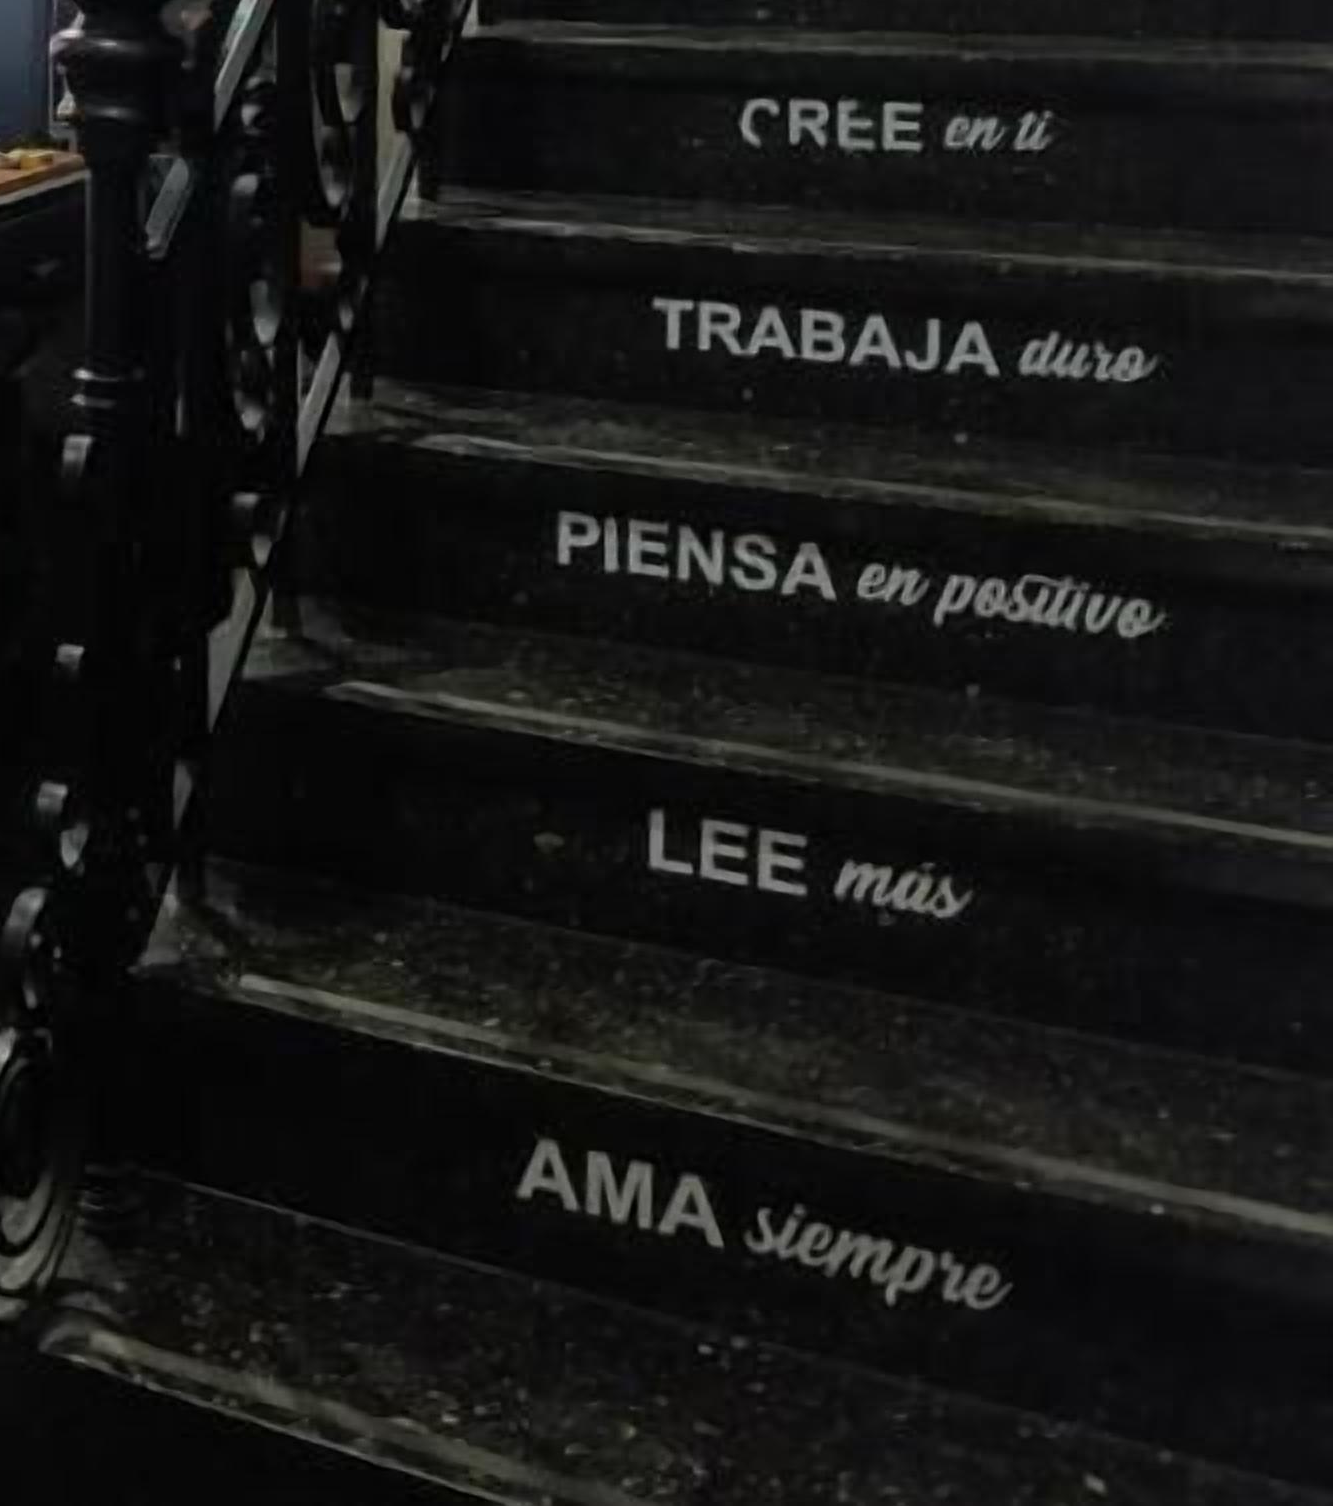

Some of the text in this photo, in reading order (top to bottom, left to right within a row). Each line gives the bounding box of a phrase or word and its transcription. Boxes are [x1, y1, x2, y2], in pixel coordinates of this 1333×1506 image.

[738, 97, 1055, 153] CREE en ti
[652, 297, 1159, 383] TRABAJA duro
[555, 511, 1169, 641] PIENSA en positivo
[647, 809, 975, 922] LEE más
[514, 1137, 1014, 1312] AMA siempre
